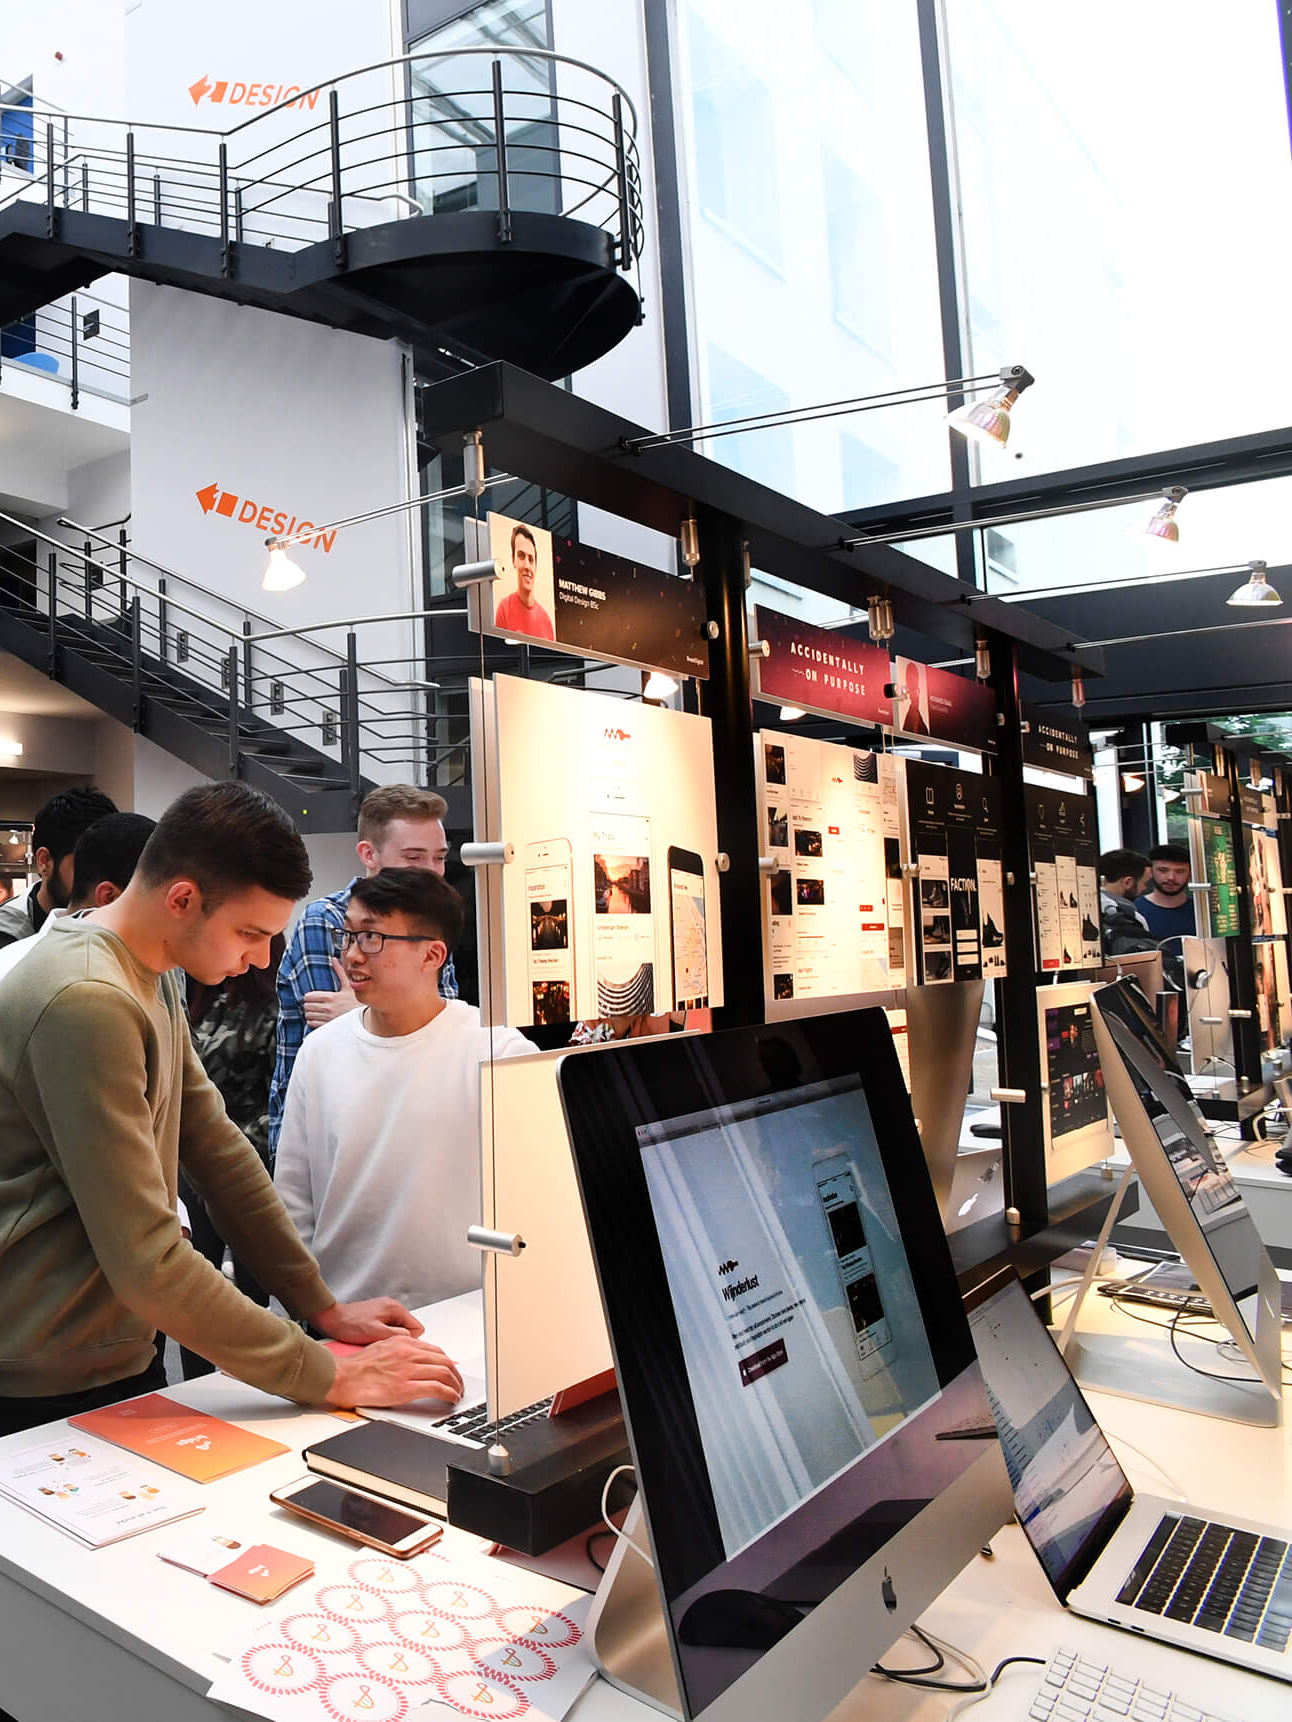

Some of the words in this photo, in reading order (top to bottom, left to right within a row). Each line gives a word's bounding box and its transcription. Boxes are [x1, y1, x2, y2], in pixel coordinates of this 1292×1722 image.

[229, 82, 320, 110] DESIGN
[238, 500, 337, 553] DESIGN
[558, 578, 588, 594] MATTHEW
[790, 641, 864, 675] ACCIDENTALLY
[805, 668, 818, 682] ON
[824, 673, 866, 696] PURPOSE
[1038, 724, 1078, 744] ACCIDENTALLY
